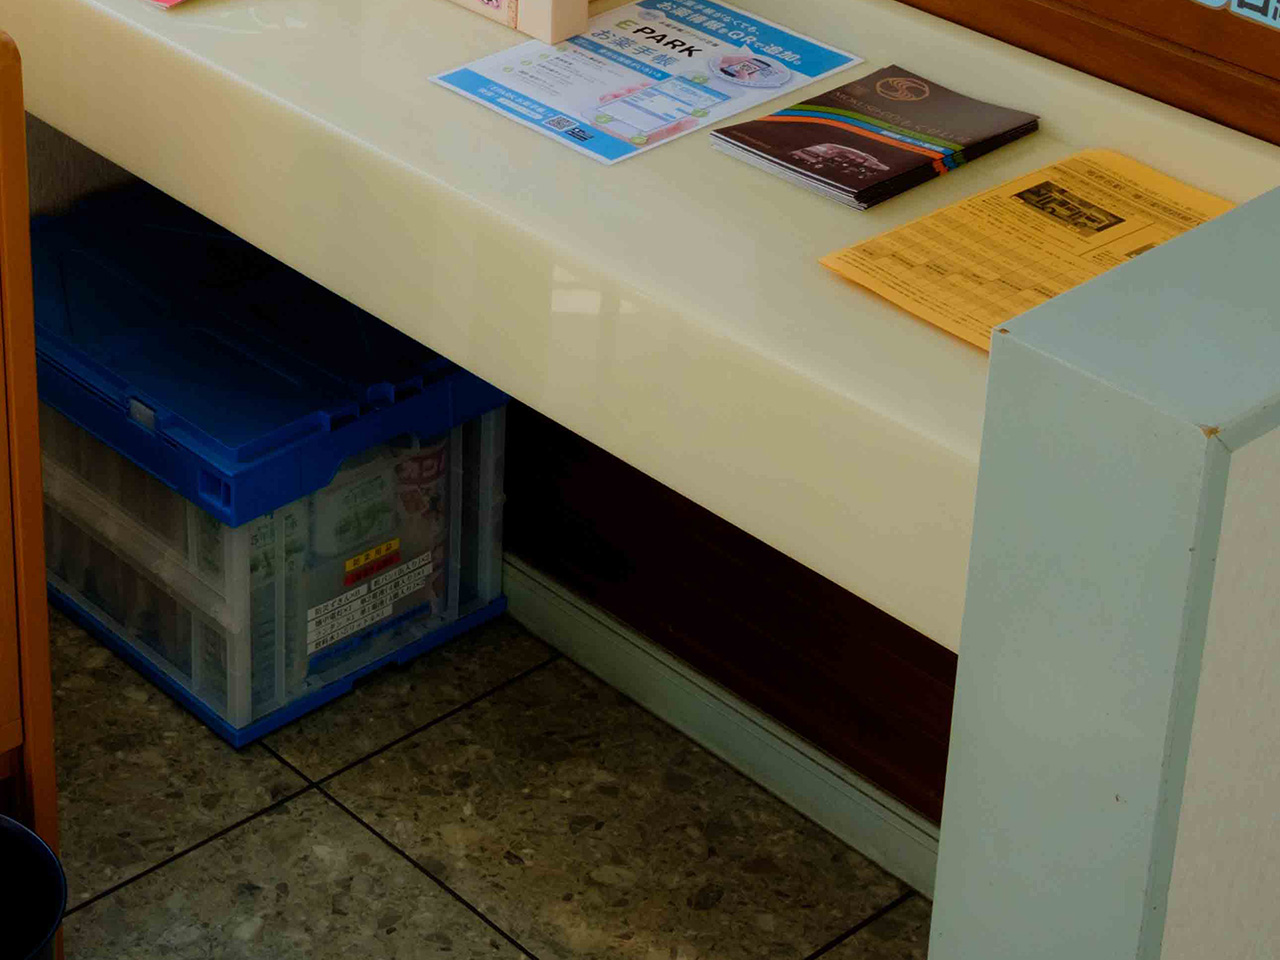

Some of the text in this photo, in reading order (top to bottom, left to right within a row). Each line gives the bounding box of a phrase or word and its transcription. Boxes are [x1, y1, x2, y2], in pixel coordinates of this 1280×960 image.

[591, 29, 679, 67] お薬手帳
[656, 1, 802, 66] お薬情報をQRで追加。
